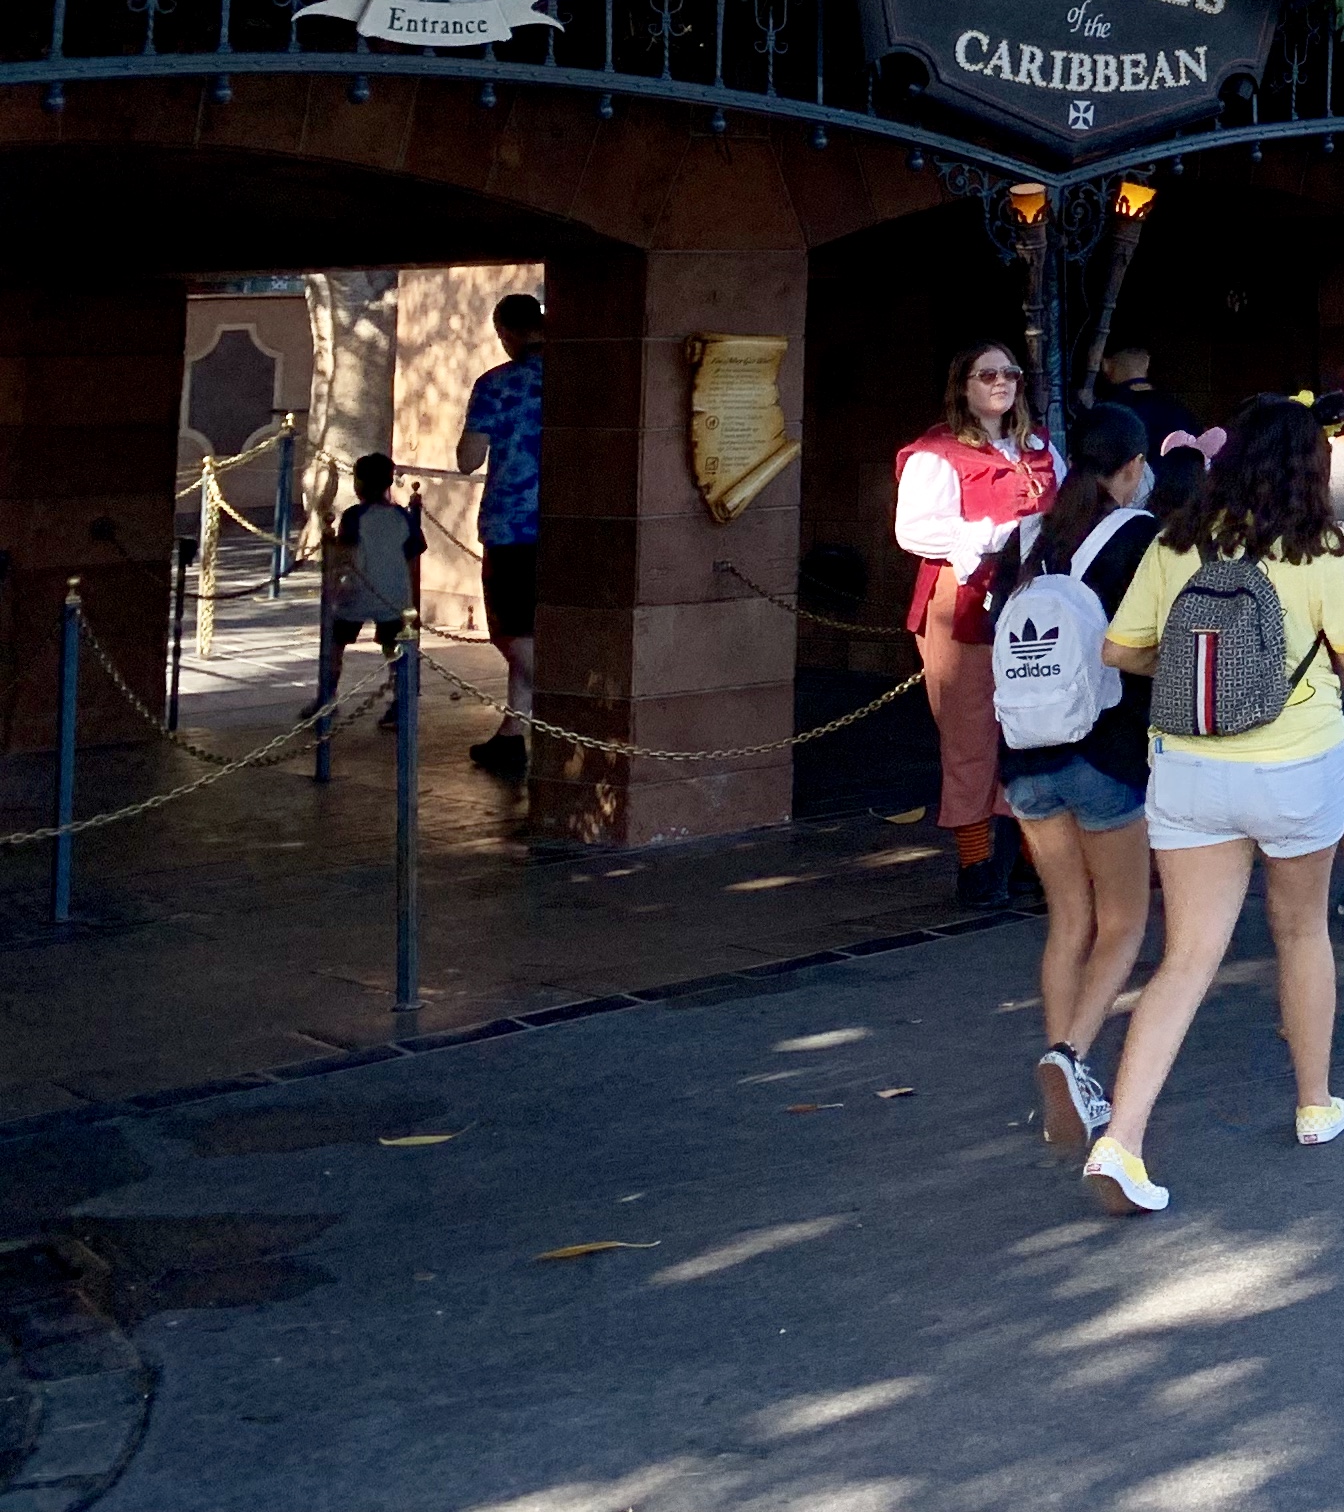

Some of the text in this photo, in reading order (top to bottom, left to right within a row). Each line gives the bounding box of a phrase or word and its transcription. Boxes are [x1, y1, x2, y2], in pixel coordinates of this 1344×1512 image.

[387, 7, 489, 35] Entrance
[1066, 0, 1112, 39] of the
[953, 29, 1210, 93] CARIBBEAN
[1005, 663, 1062, 680] adidas
